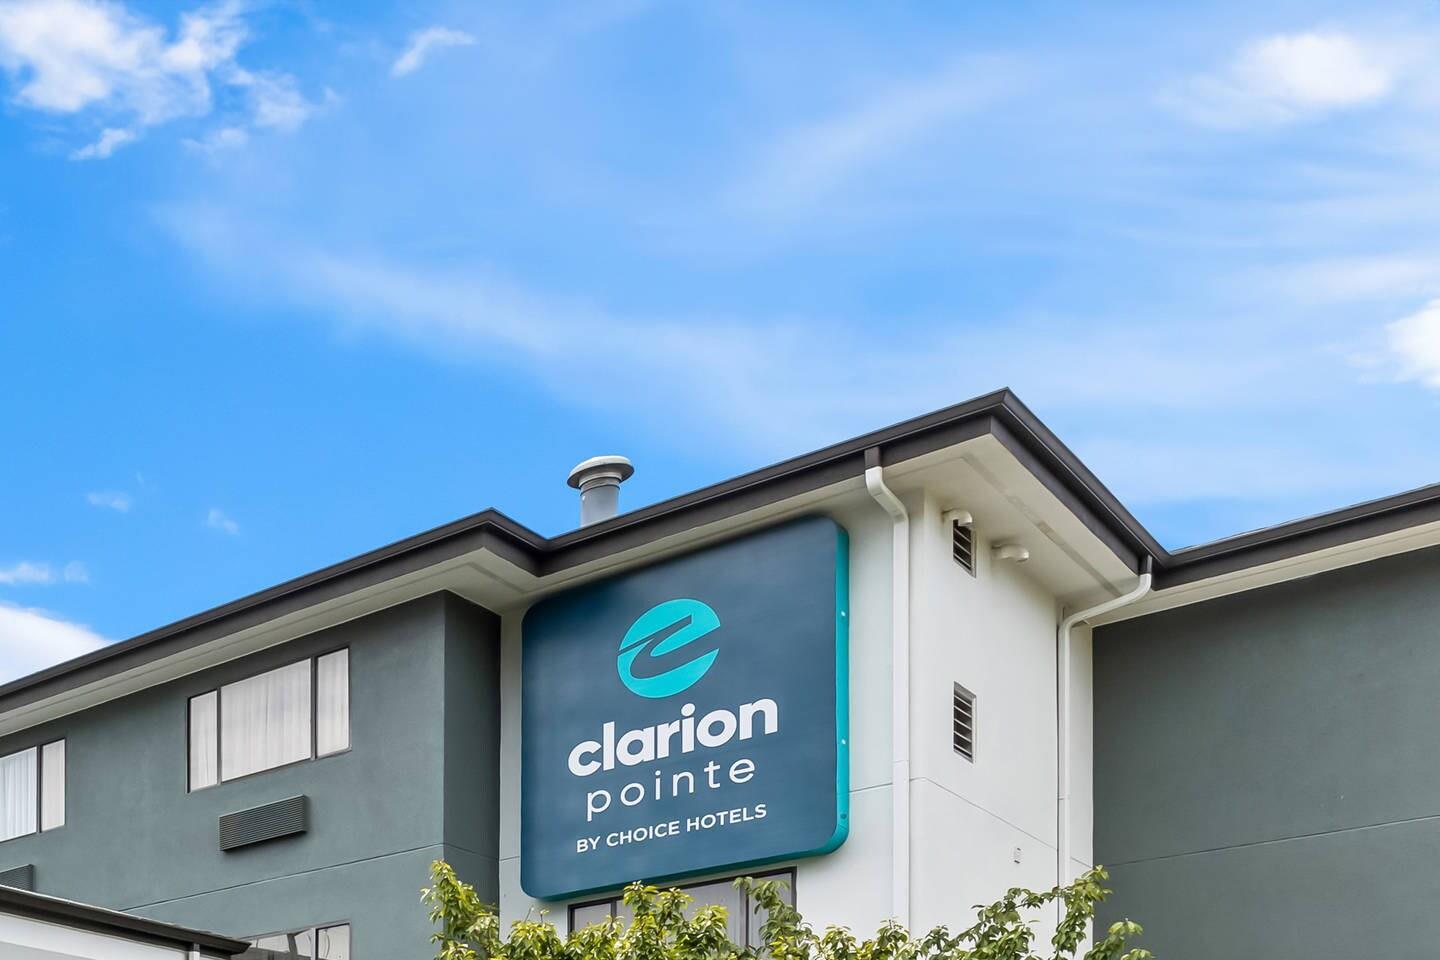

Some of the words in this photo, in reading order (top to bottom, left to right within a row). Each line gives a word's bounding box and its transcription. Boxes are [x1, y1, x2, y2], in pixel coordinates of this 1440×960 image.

[567, 697, 778, 777] clarion
[586, 757, 756, 821] pointe
[576, 836, 600, 853] BY
[606, 820, 680, 847] CHOICE
[686, 803, 767, 832] HOTELS
